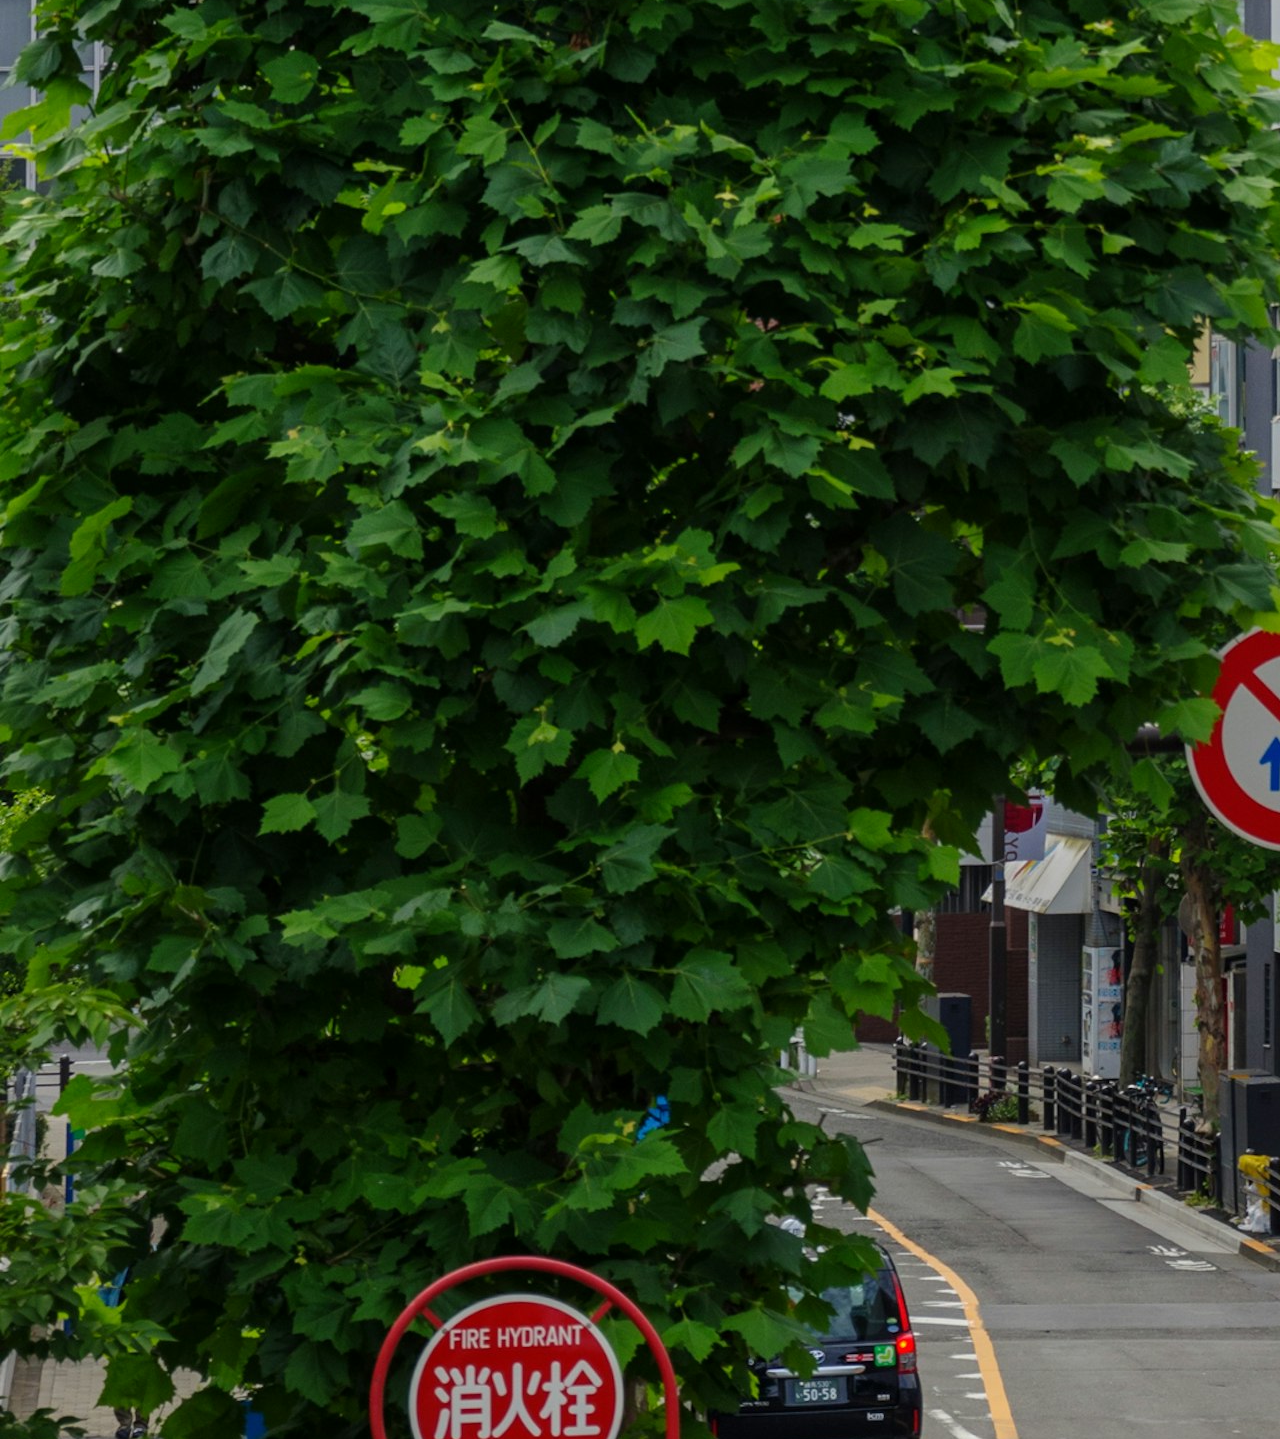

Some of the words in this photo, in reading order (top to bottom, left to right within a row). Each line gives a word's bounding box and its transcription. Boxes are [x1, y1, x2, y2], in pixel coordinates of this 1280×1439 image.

[450, 1328, 491, 1350] FIRE
[497, 1325, 584, 1348] HYDRANT
[803, 1388, 837, 1402] 50-58
